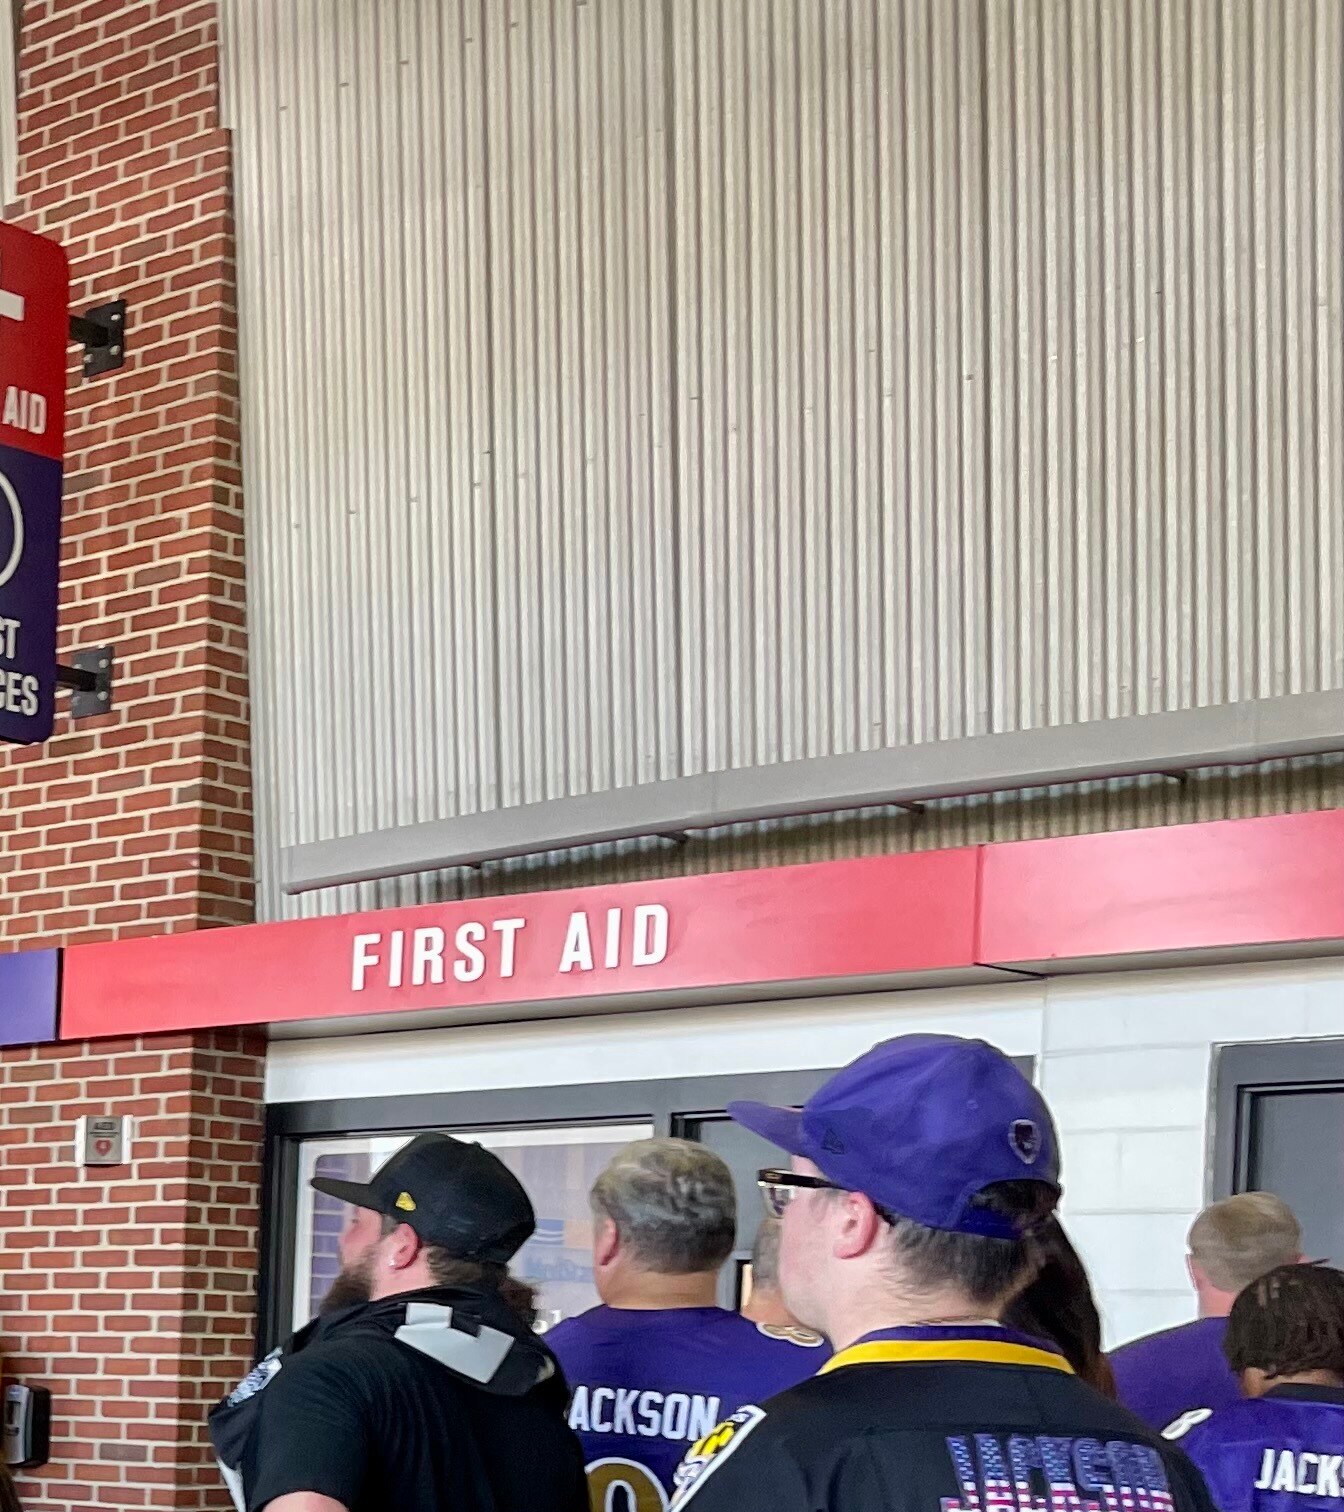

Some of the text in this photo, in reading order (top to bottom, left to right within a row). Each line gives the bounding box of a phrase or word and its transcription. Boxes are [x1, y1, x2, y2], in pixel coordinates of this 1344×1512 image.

[2, 385, 47, 436] AID
[351, 902, 670, 992] FIRST AID
[566, 1385, 721, 1442] ACKSON
[1254, 1448, 1344, 1499] JACK
